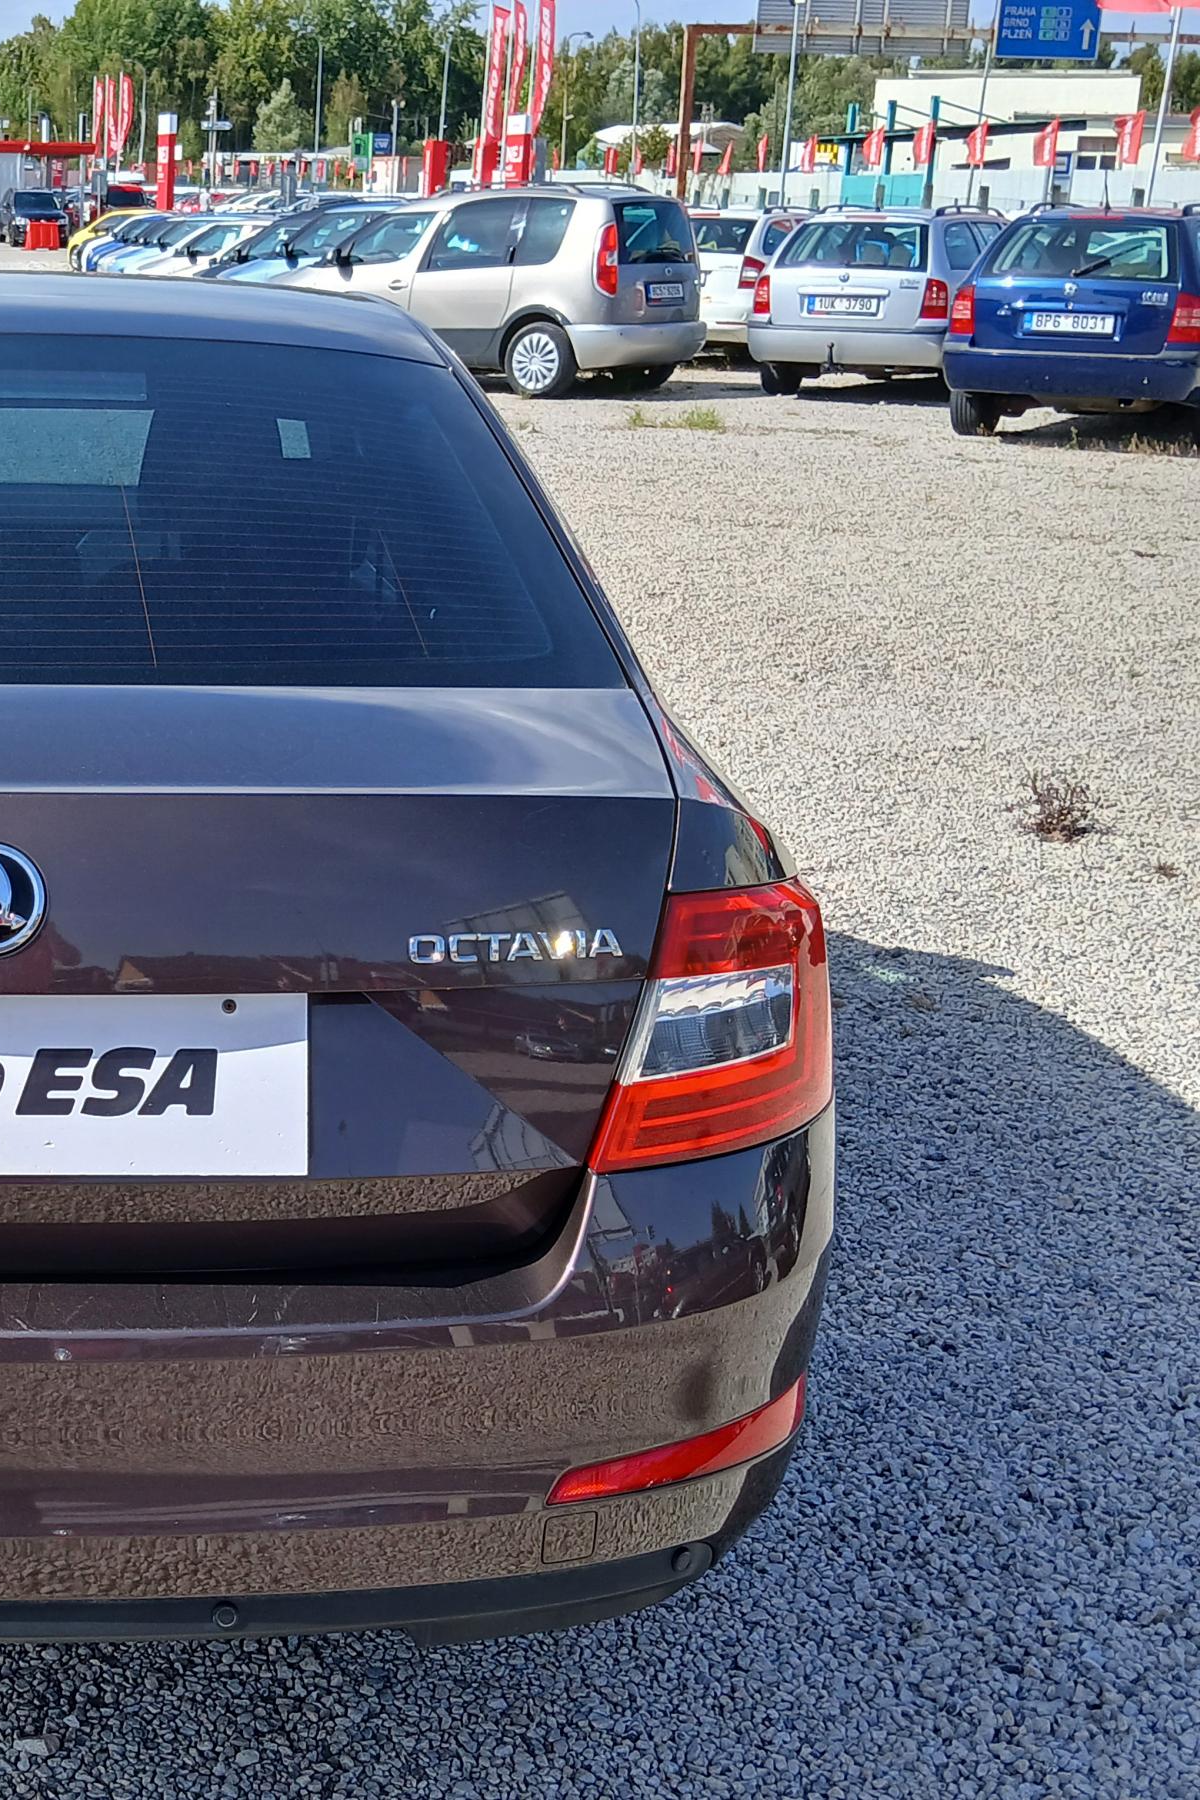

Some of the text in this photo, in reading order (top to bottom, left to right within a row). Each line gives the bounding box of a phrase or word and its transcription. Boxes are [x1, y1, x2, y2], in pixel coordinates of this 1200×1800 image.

[1004, 6, 1037, 17] PRAHA
[1003, 18, 1030, 28] BRNO
[1001, 28, 1033, 39] PLZEŇ
[819, 299, 872, 310] 1UK 3790
[1035, 314, 1107, 330] 8P6 8031
[408, 928, 625, 964] OCTAVIA
[15, 1047, 219, 1117] ESA
